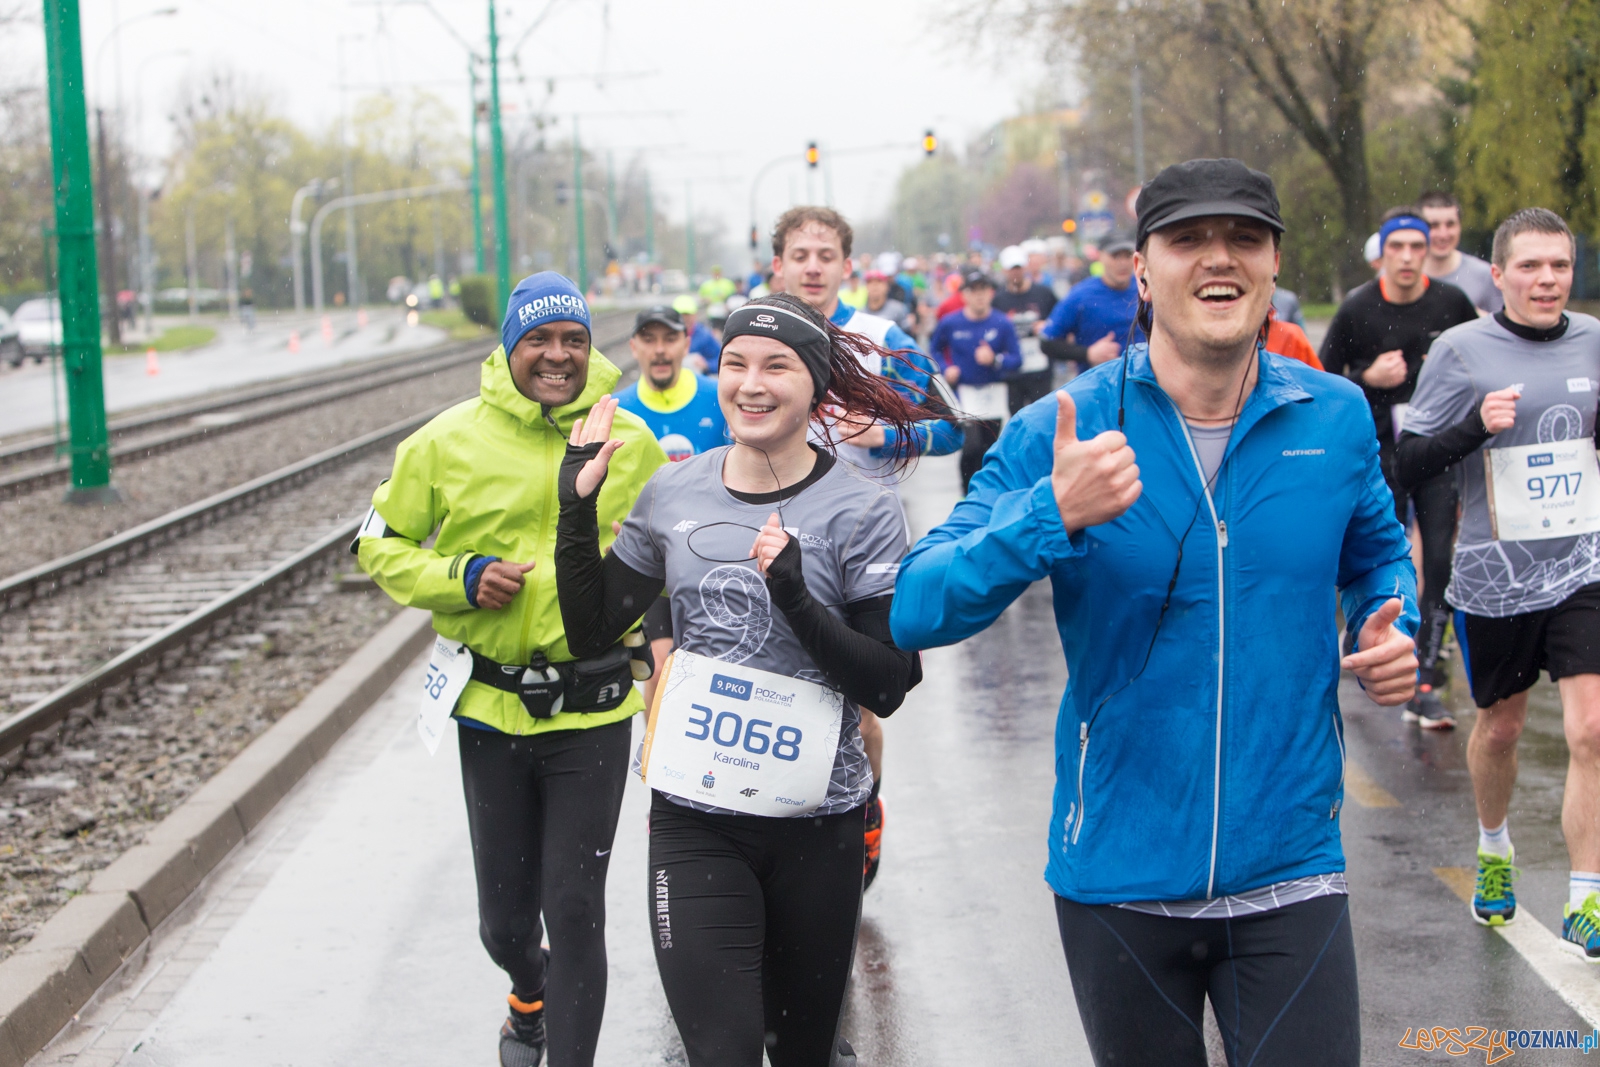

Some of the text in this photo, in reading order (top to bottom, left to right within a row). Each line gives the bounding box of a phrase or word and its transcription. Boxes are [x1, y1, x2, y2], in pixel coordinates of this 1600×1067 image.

[518, 294, 586, 320] ERDINGER
[520, 306, 587, 328] ALKOHOLFREI
[749, 321, 779, 331] Kalenji
[1282, 449, 1325, 457] OUTHORN
[1527, 471, 1582, 500] 9717
[672, 519, 699, 533] 4F
[685, 703, 803, 762] 3068
[713, 751, 760, 771] Karolina
[740, 787, 759, 798] 4F
[656, 869, 672, 949] NYATHLETICS
